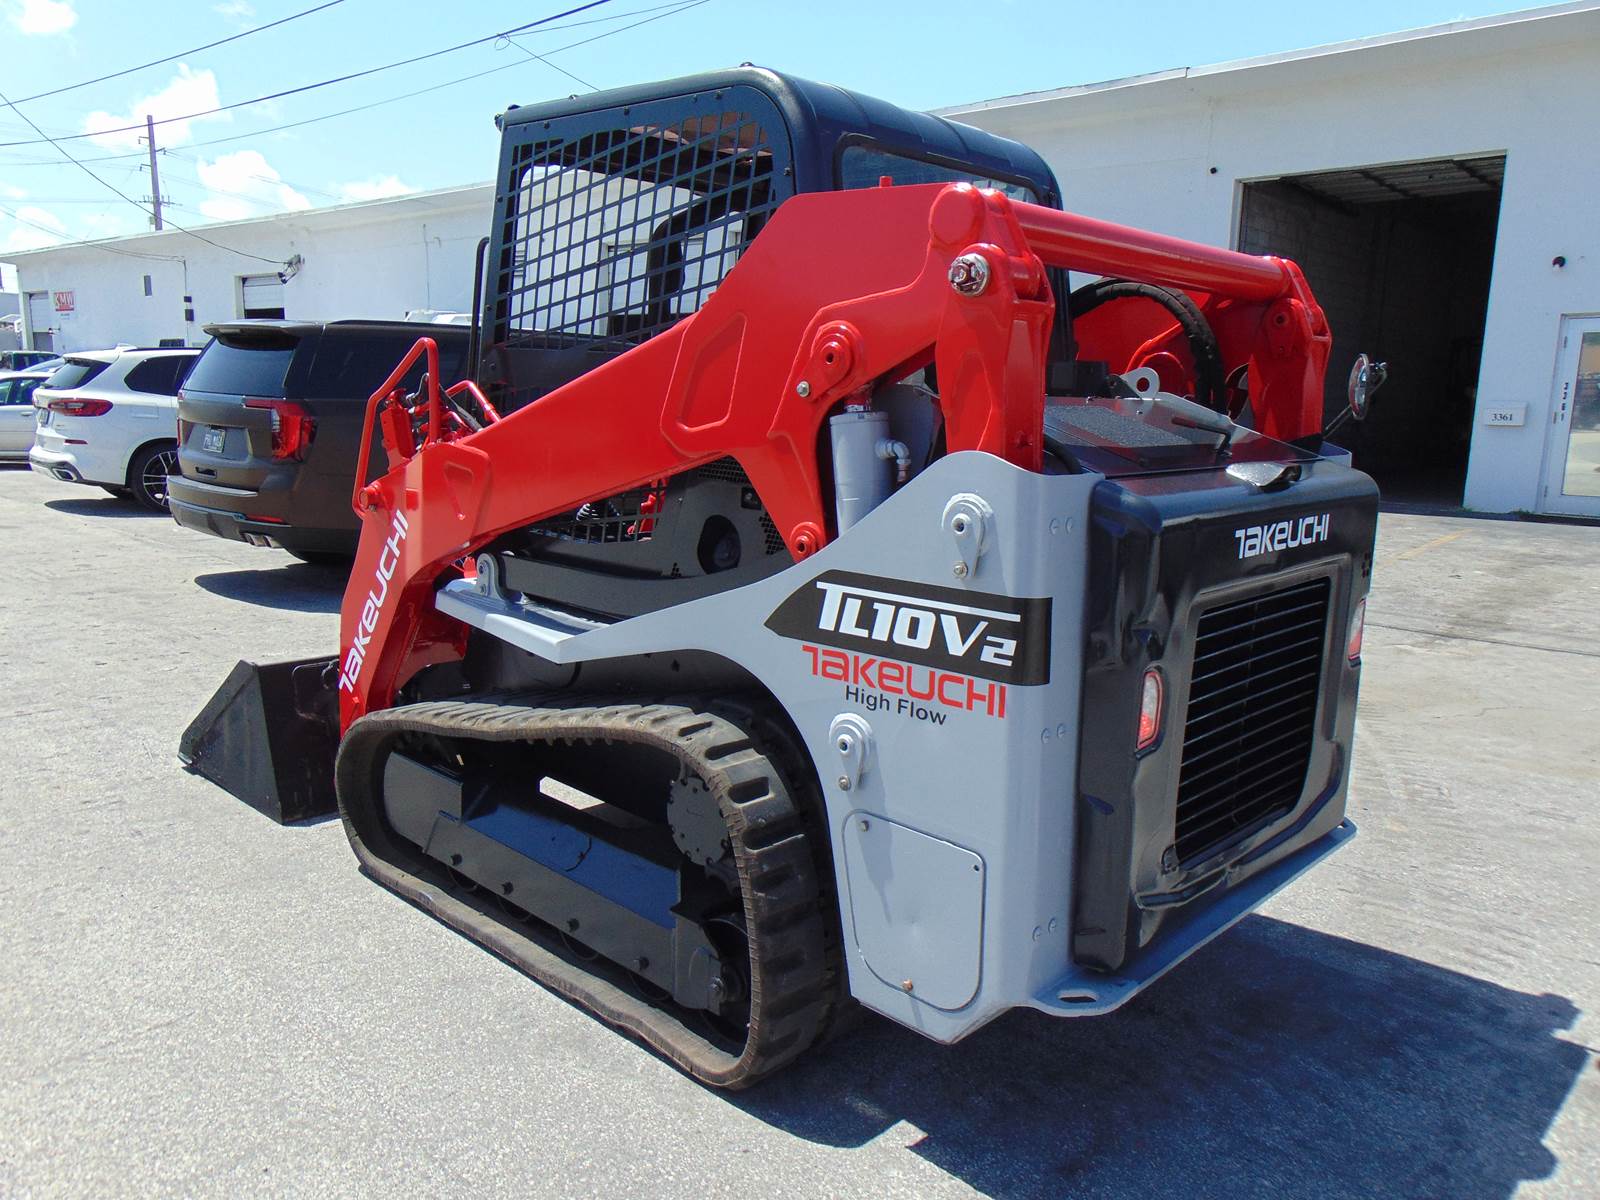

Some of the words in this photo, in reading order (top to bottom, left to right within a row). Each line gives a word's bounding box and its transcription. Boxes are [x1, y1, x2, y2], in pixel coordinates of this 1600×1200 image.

[1491, 413, 1513, 422] 3361
[845, 685, 890, 712] High
[897, 699, 947, 726] Flow
